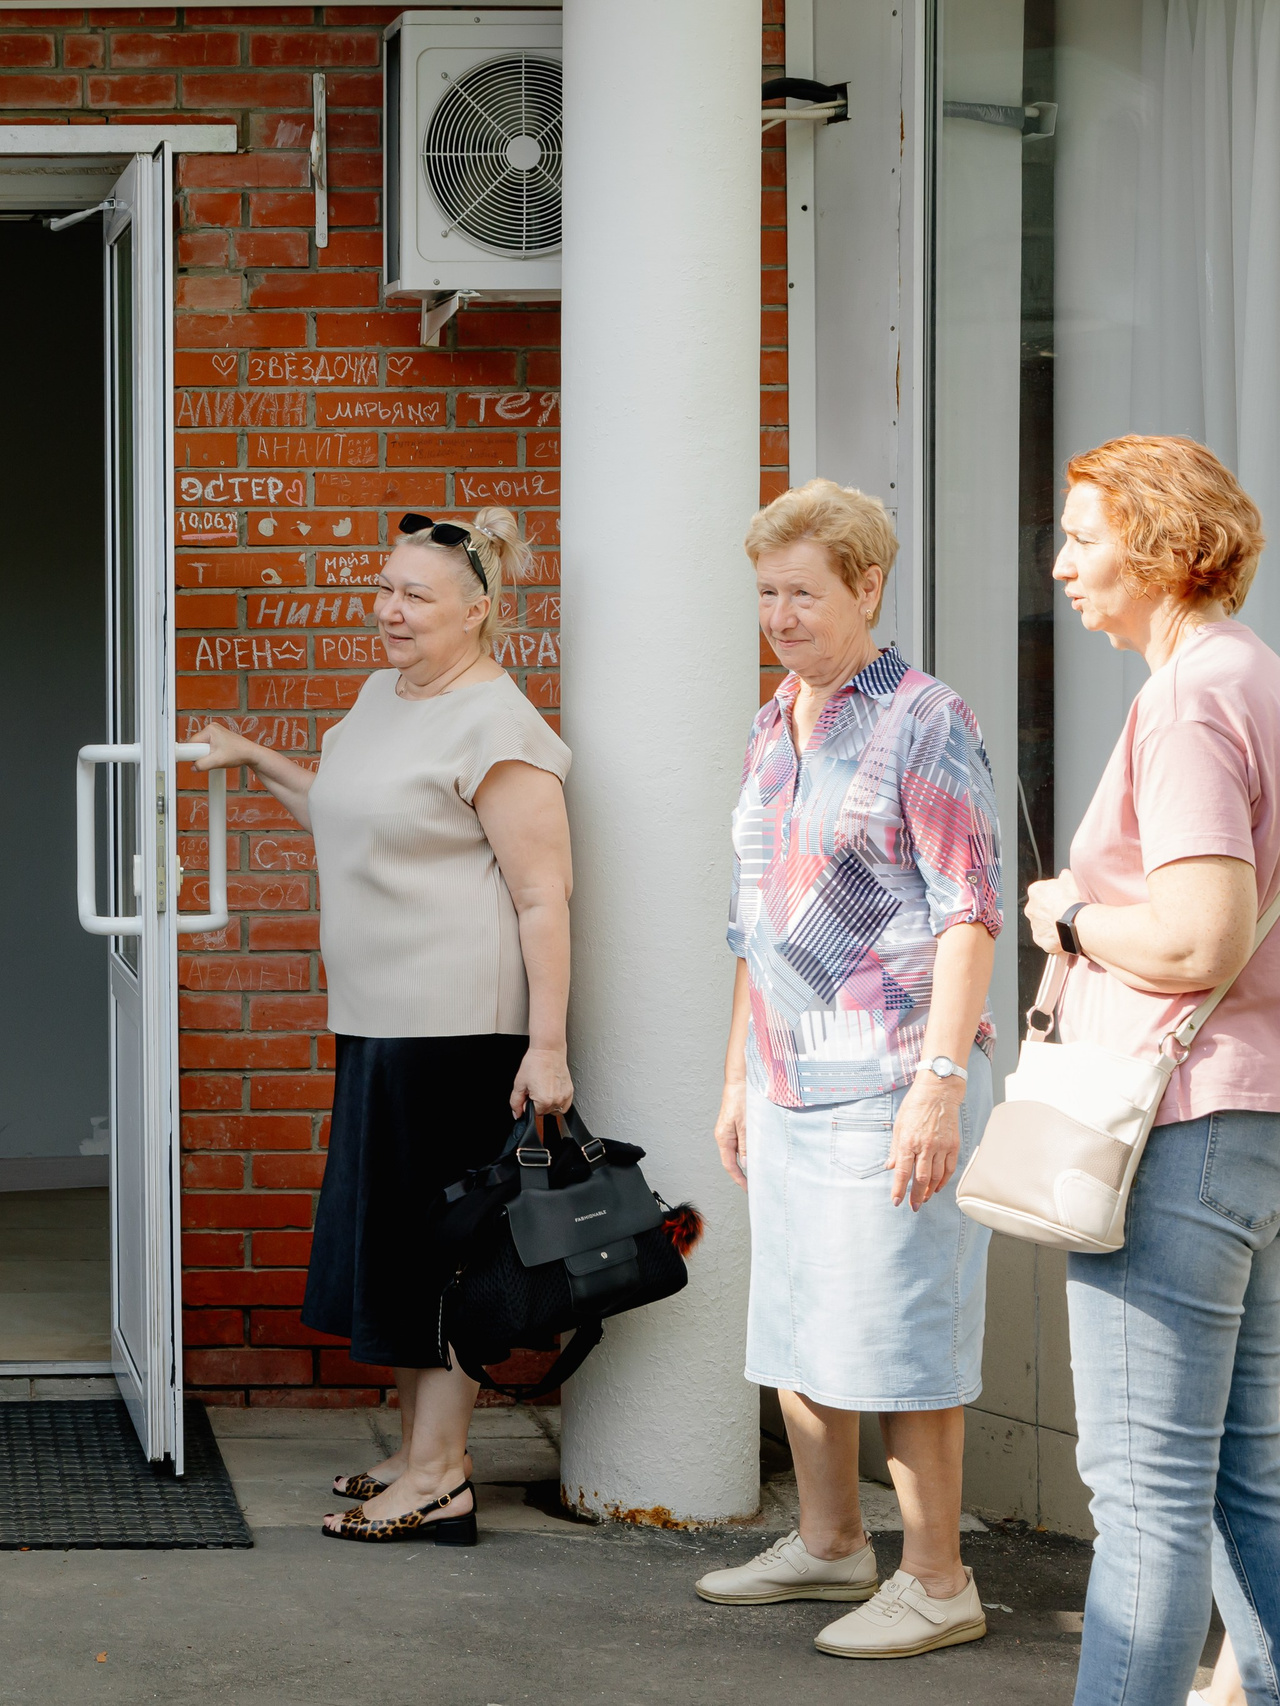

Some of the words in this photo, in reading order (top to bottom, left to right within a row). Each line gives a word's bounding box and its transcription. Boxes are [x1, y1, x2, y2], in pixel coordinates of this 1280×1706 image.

[249, 352, 379, 385] ЗВЁЗДОЧКА
[177, 391, 307, 427] АЛИХАН
[257, 433, 347, 465] АНАИТ
[180, 473, 284, 504] ЭСТЕР
[256, 596, 367, 627] НИНА
[195, 636, 274, 670] АРЕН
